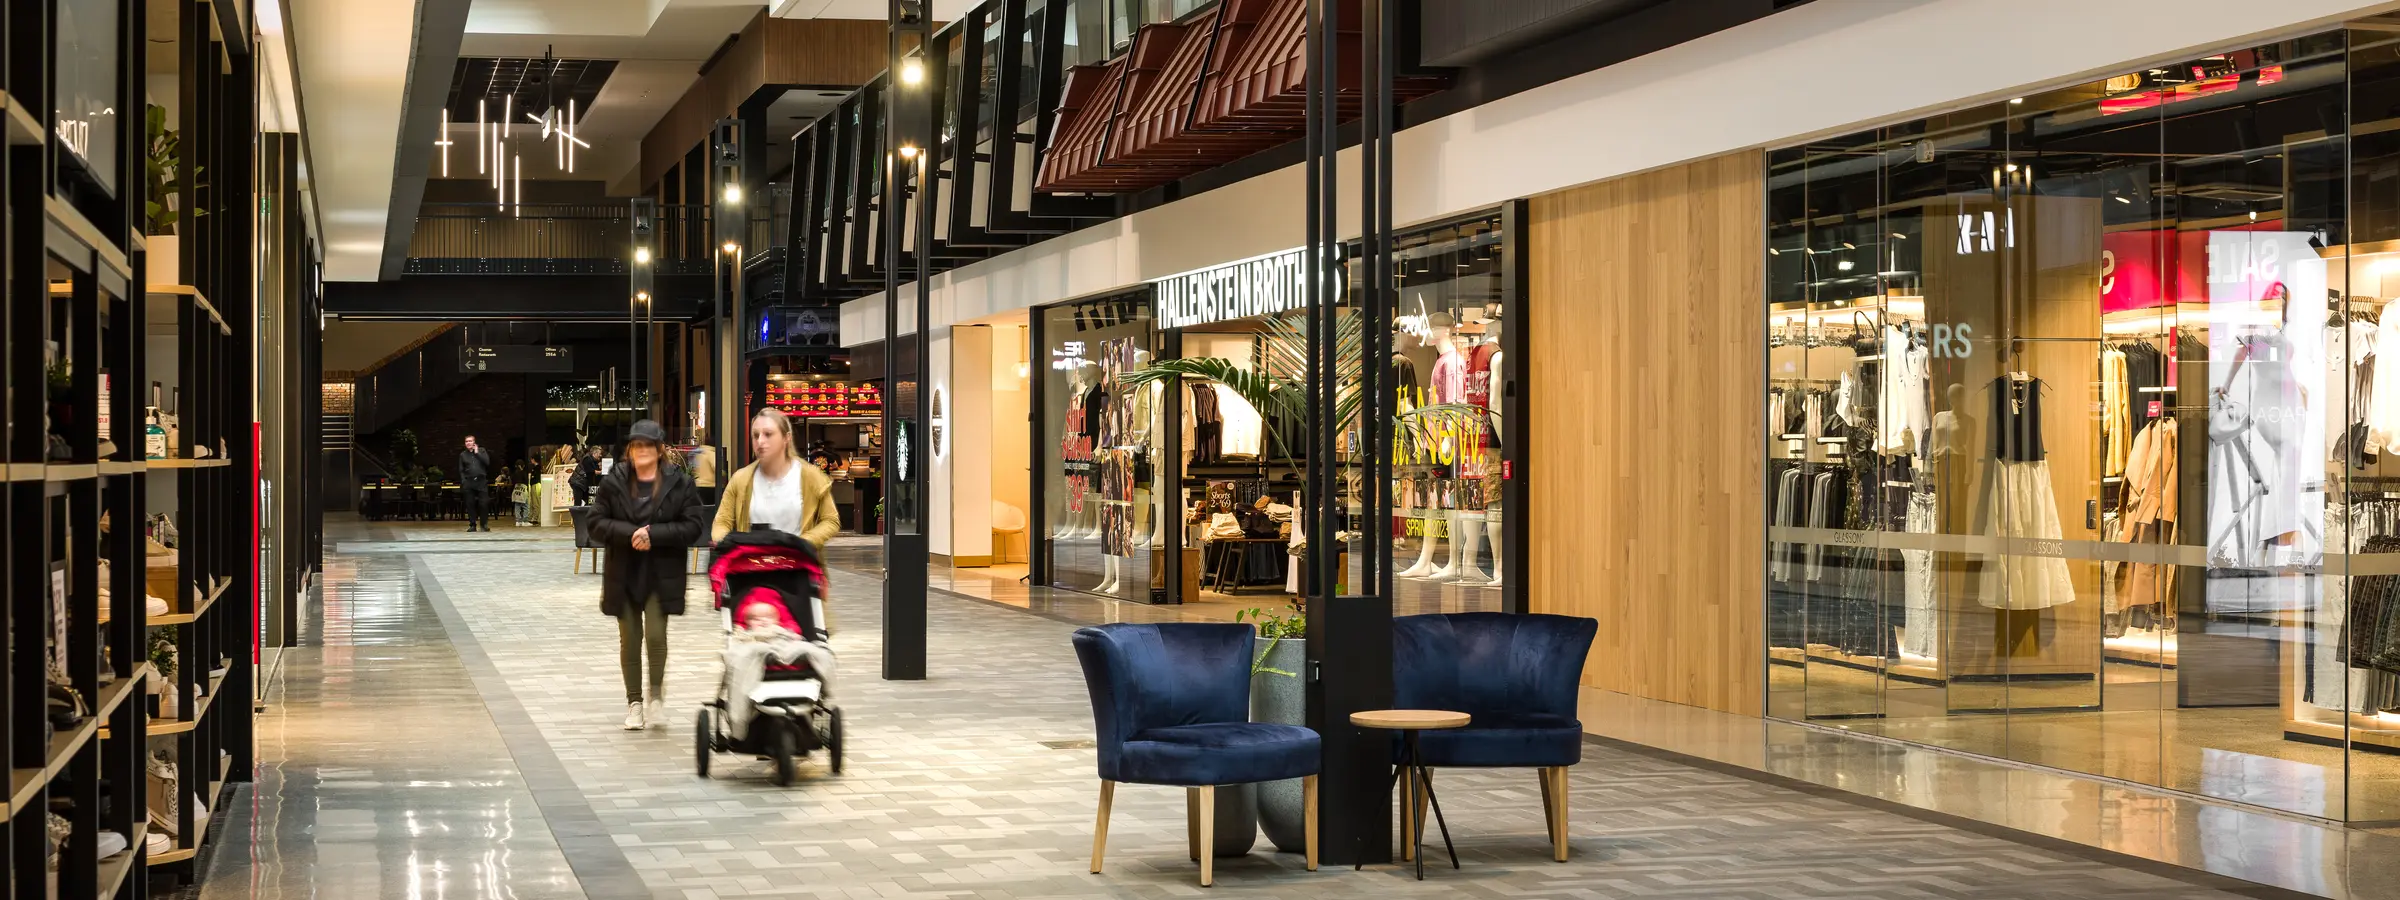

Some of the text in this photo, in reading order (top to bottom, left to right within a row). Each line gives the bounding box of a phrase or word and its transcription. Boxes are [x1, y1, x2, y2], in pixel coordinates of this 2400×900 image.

[1158, 243, 1342, 330] HALLENSTEIN BROTH
[1062, 436, 1092, 460] season
[1432, 519, 1450, 538] 2023
